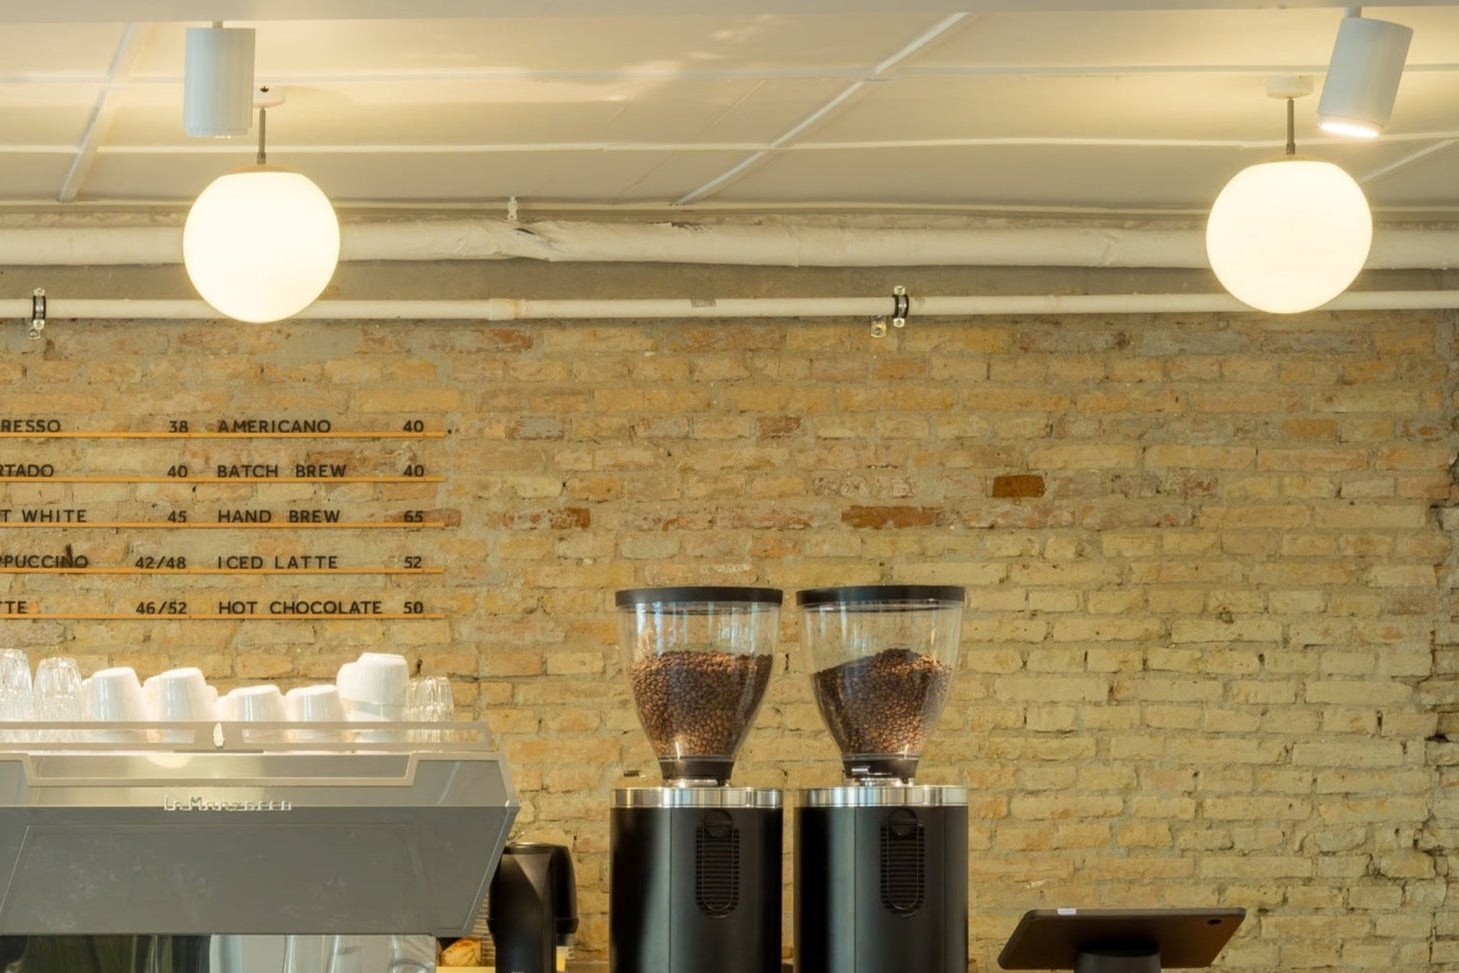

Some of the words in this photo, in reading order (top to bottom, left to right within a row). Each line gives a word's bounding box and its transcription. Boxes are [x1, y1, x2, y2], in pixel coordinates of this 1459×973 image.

[168, 421, 189, 433] 38
[218, 420, 331, 433] AMERICANO
[403, 420, 424, 433] 40
[167, 466, 188, 478] 40
[217, 465, 278, 478] BATCH
[295, 465, 346, 478] BREW
[403, 465, 424, 478] 40
[22, 509, 86, 523] WHITE
[167, 511, 187, 523] 45
[218, 510, 271, 523] HAND
[289, 510, 340, 523] BREW
[403, 511, 424, 523] 65
[135, 556, 187, 569] 42/48
[218, 556, 263, 569] ICED
[275, 556, 338, 569] LATTE
[404, 556, 422, 569] 52
[136, 602, 187, 615] 46/52
[219, 601, 258, 614] HOT
[270, 601, 382, 614] CHOCOLATE
[404, 601, 424, 614] 50
